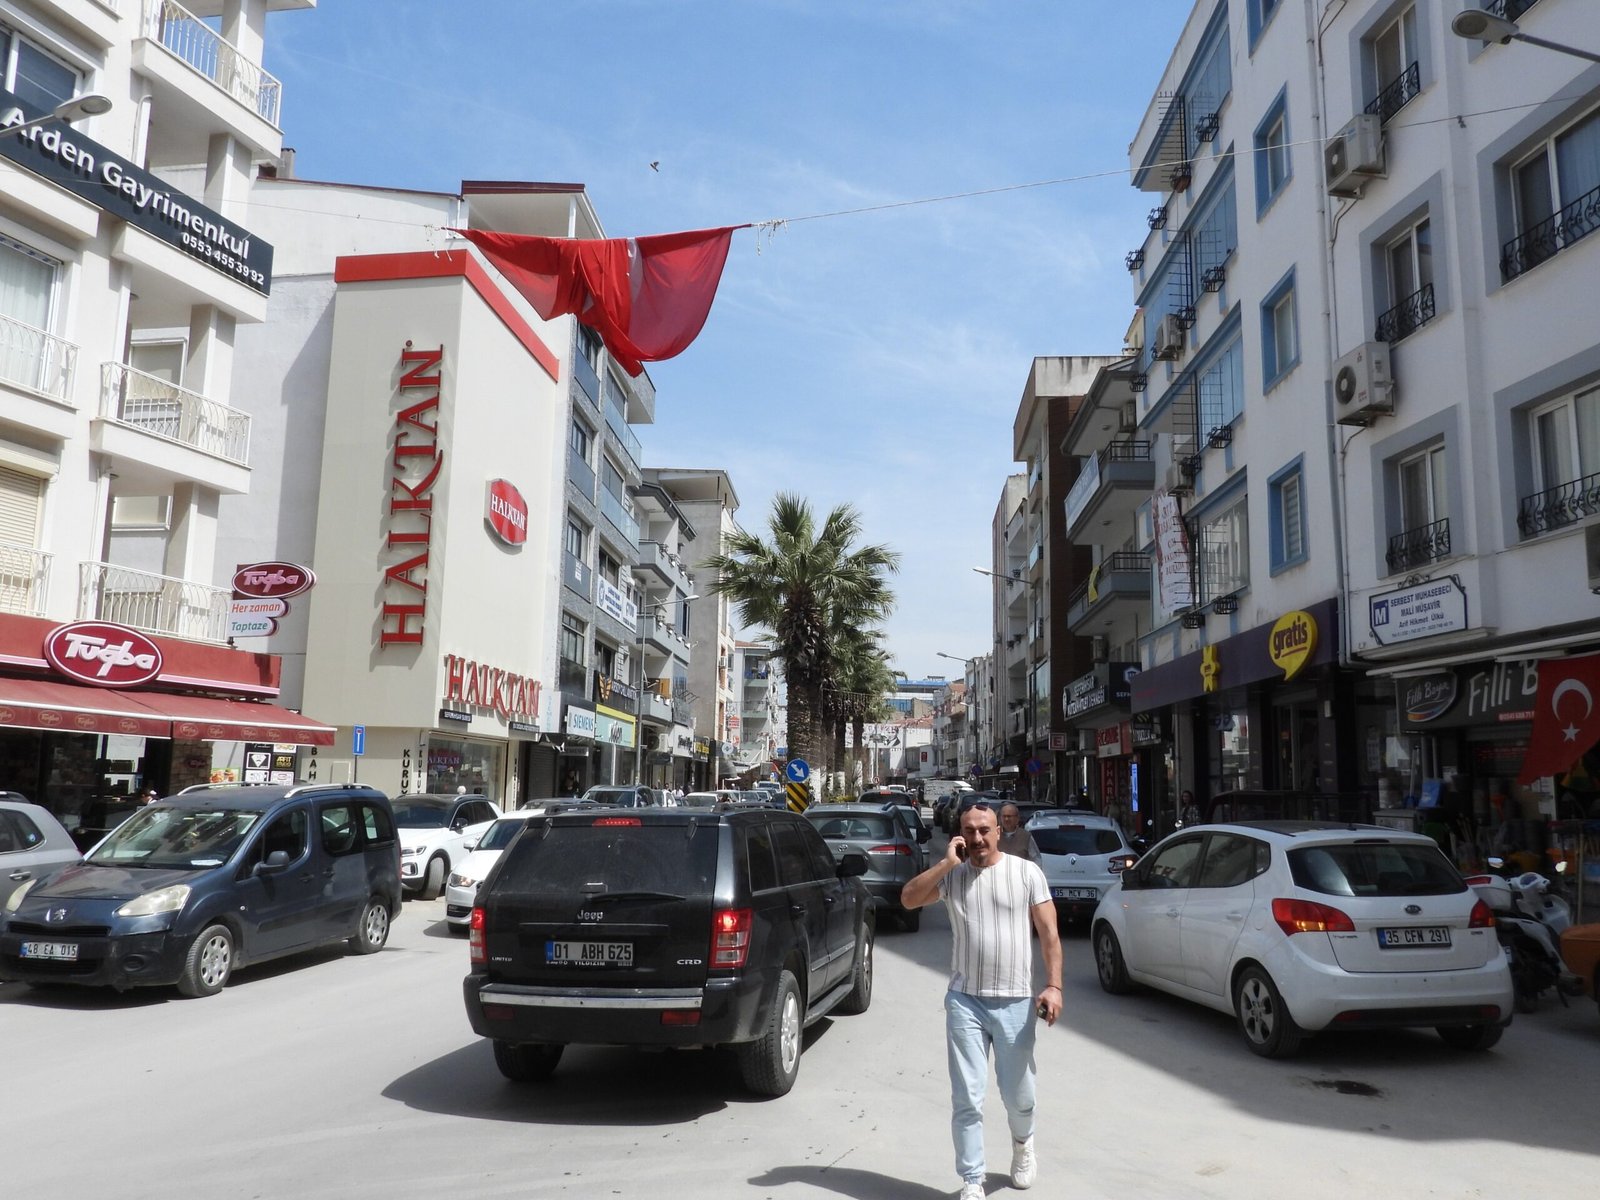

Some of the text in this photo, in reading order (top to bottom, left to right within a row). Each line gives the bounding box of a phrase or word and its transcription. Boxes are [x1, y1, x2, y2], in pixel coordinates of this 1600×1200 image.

[1, 107, 249, 259] Arden Gayrimenkul
[181, 232, 265, 285] 0553 455 39 92
[381, 344, 444, 649] HALKTAN
[491, 493, 526, 531] HALKTAN
[1390, 584, 1452, 607] SERBEST MUHASEBECİ
[231, 602, 280, 613] Her zaman
[1400, 605, 1414, 617] MALİ
[231, 622, 268, 633] Taptaze
[1273, 615, 1308, 659] gratis
[446, 654, 541, 719] HALKTAN
[1469, 662, 1513, 717] Filli
[573, 714, 594, 731] SIEMENS
[1056, 889, 1064, 897] 35
[577, 910, 604, 922] Jeep
[1386, 929, 1448, 944] 35 CFN 291
[28, 943, 77, 956] 48 EA 015
[553, 943, 632, 961] 01 ABH 625
[676, 958, 702, 966] CRD
